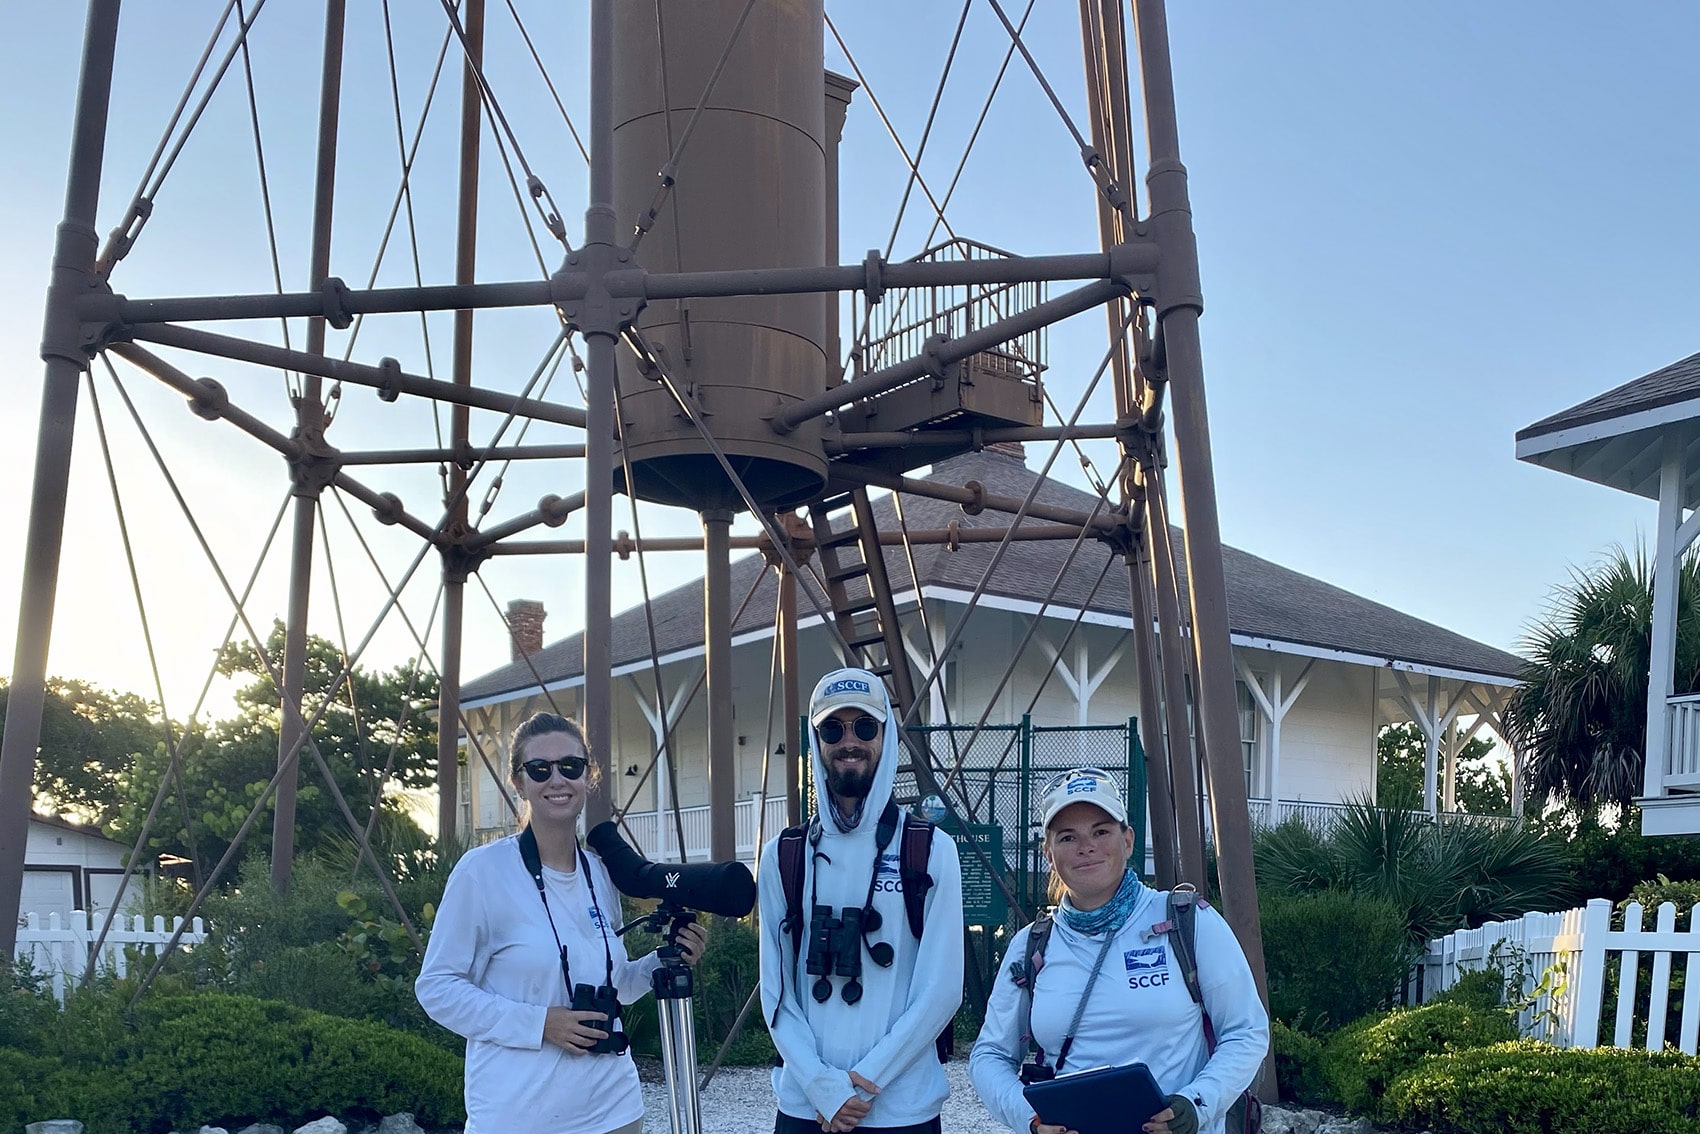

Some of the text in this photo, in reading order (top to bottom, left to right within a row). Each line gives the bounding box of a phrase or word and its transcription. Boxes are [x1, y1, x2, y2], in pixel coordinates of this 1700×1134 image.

[837, 680, 868, 691] SCCF
[1067, 786, 1097, 795] SCCF
[873, 880, 903, 893] SCC
[1128, 973, 1170, 989] SCCF
